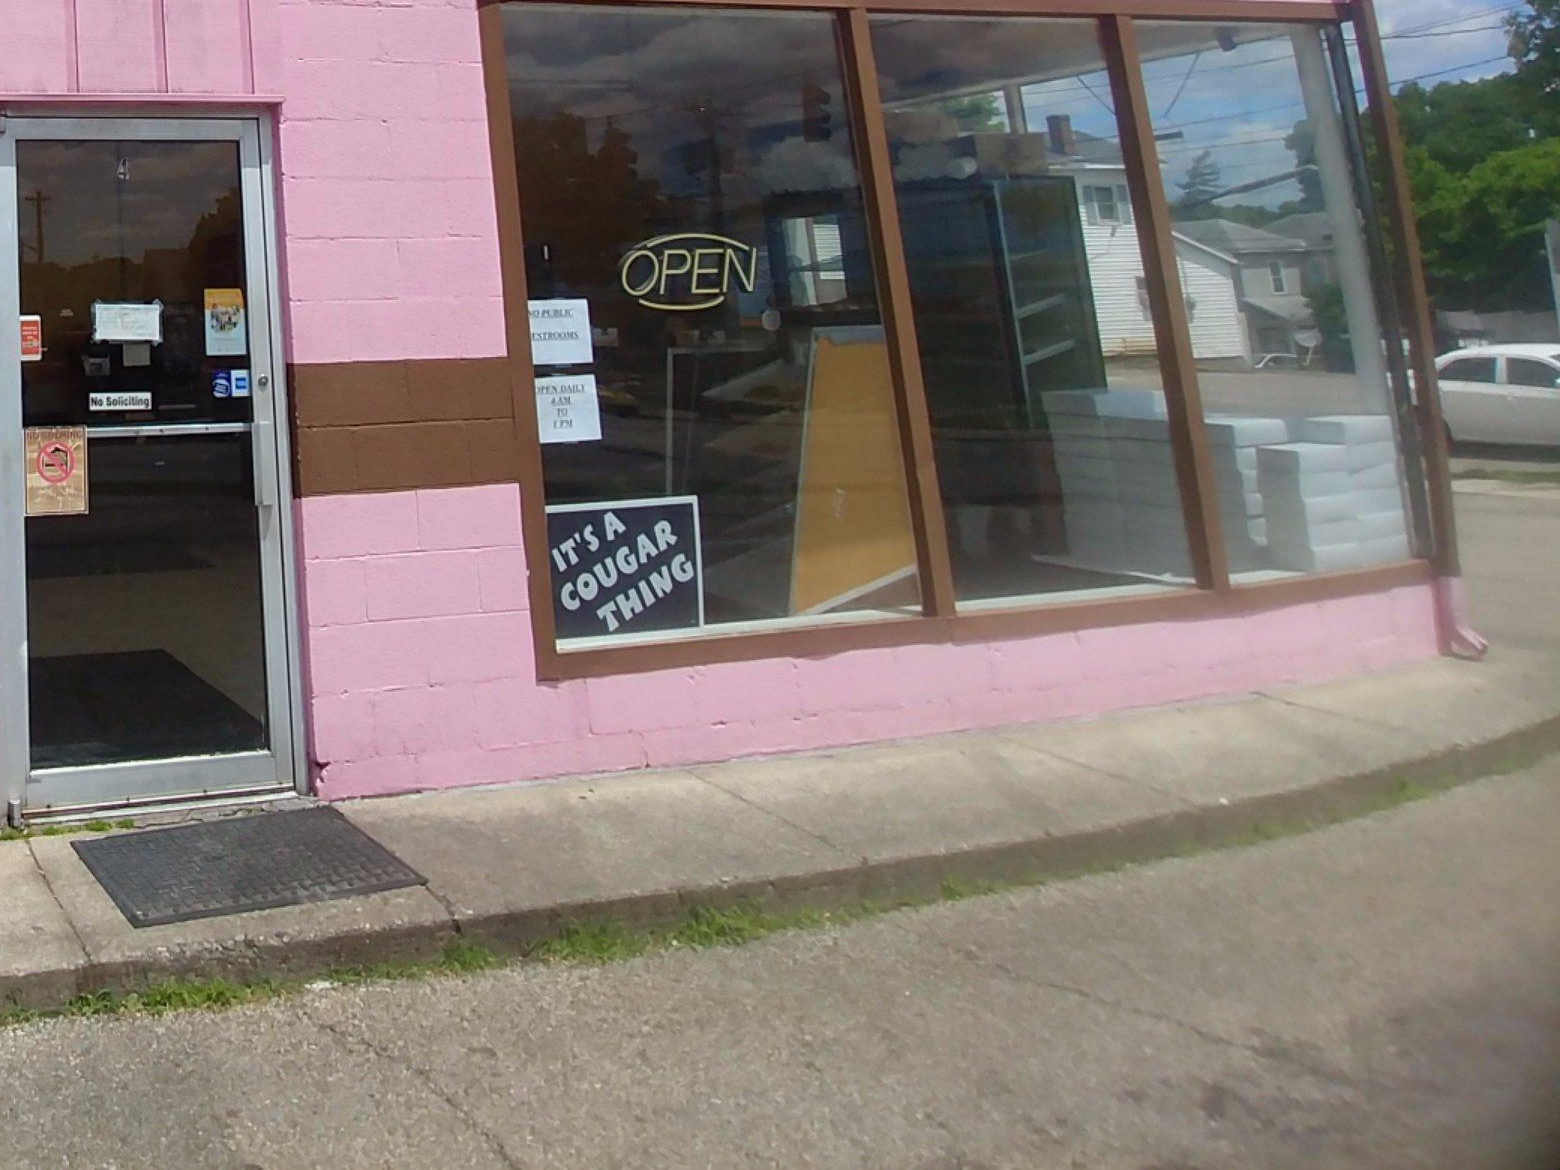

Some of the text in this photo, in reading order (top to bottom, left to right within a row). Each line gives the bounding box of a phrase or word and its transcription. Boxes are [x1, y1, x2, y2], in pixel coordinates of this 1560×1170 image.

[622, 247, 757, 296] OPEN
[91, 395, 103, 408] No
[560, 384, 585, 394] DAILY
[551, 510, 627, 573] IT'S A
[560, 519, 679, 611] COUGAR
[596, 553, 695, 633] THING
